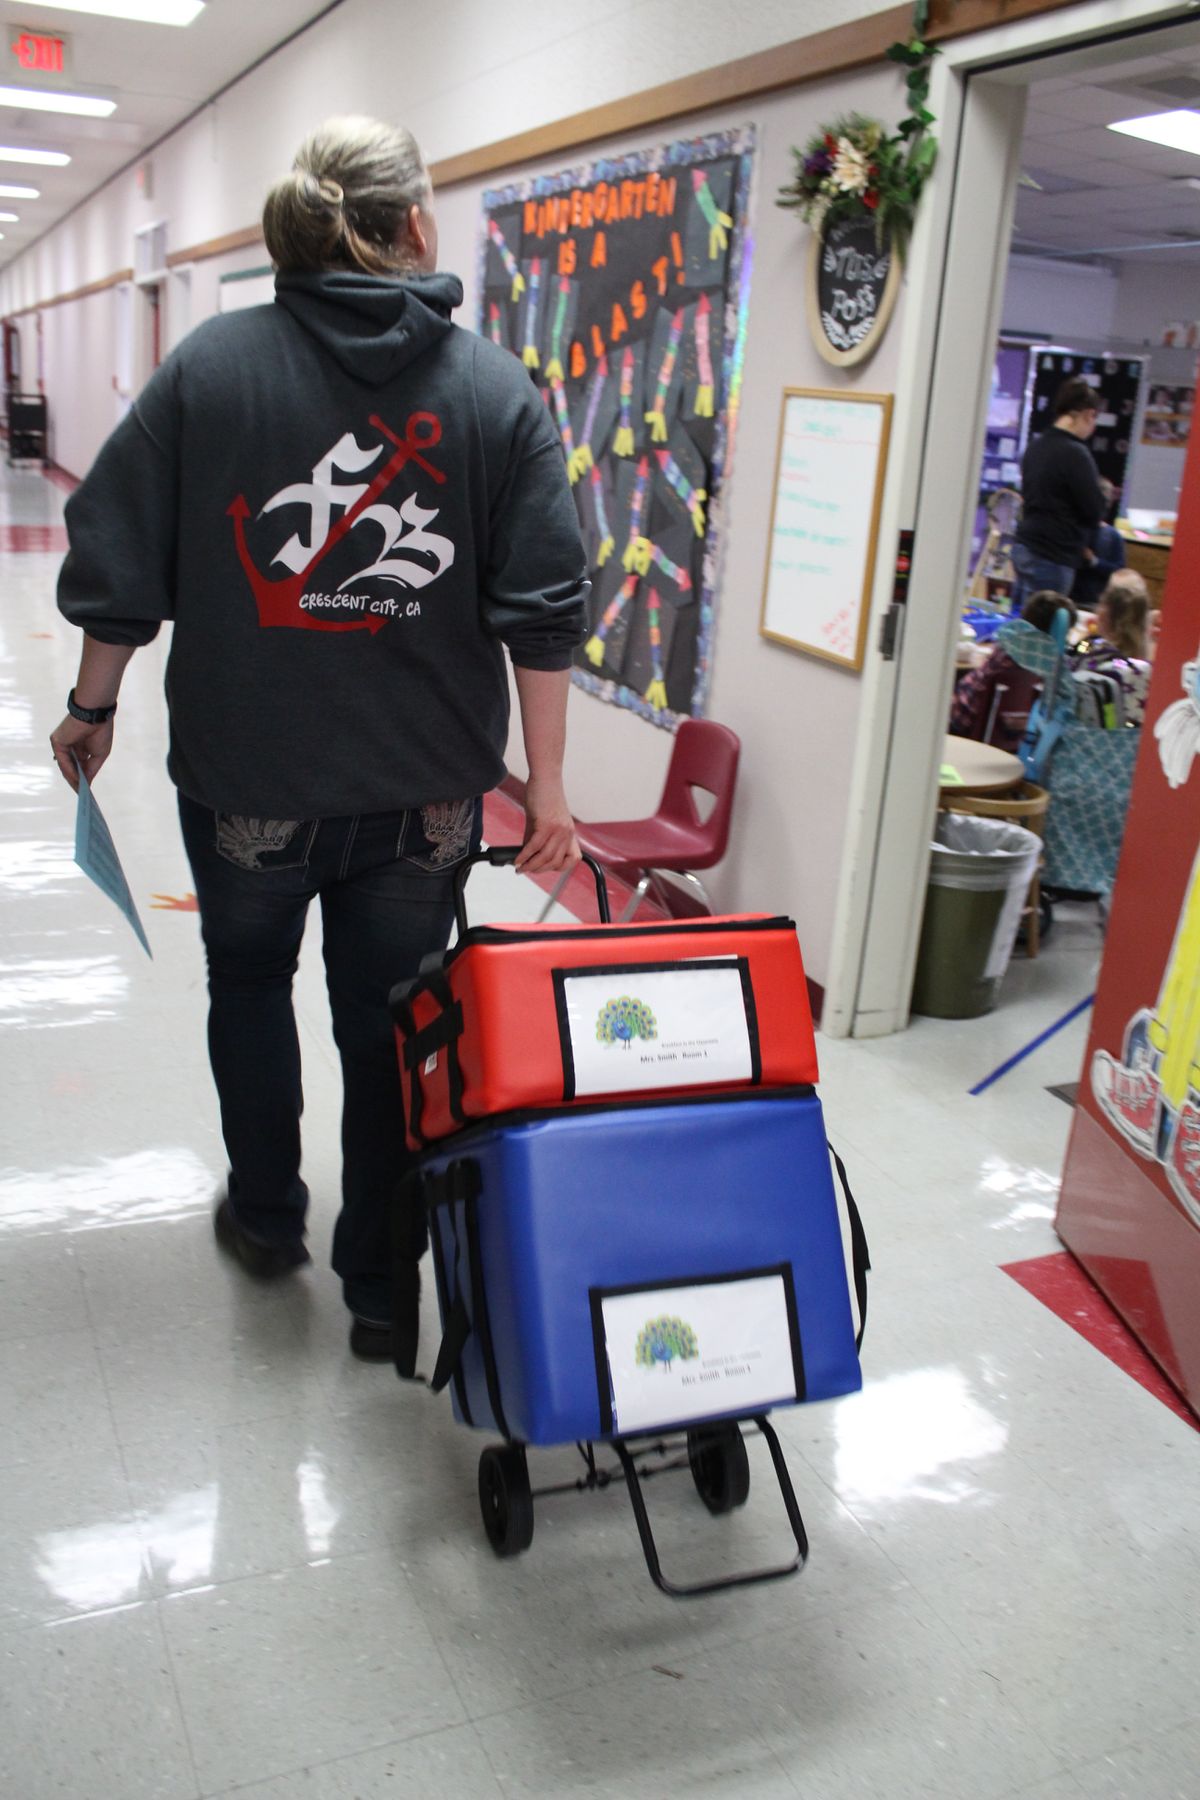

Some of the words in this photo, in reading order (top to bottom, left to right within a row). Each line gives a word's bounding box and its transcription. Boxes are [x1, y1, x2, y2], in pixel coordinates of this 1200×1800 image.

[19, 33, 65, 73] EXIT
[524, 172, 677, 239] KINDERGARTEN
[558, 239, 576, 274] IS
[591, 231, 607, 268] A
[299, 593, 370, 610] CRESCENT
[406, 602, 421, 616] CA
